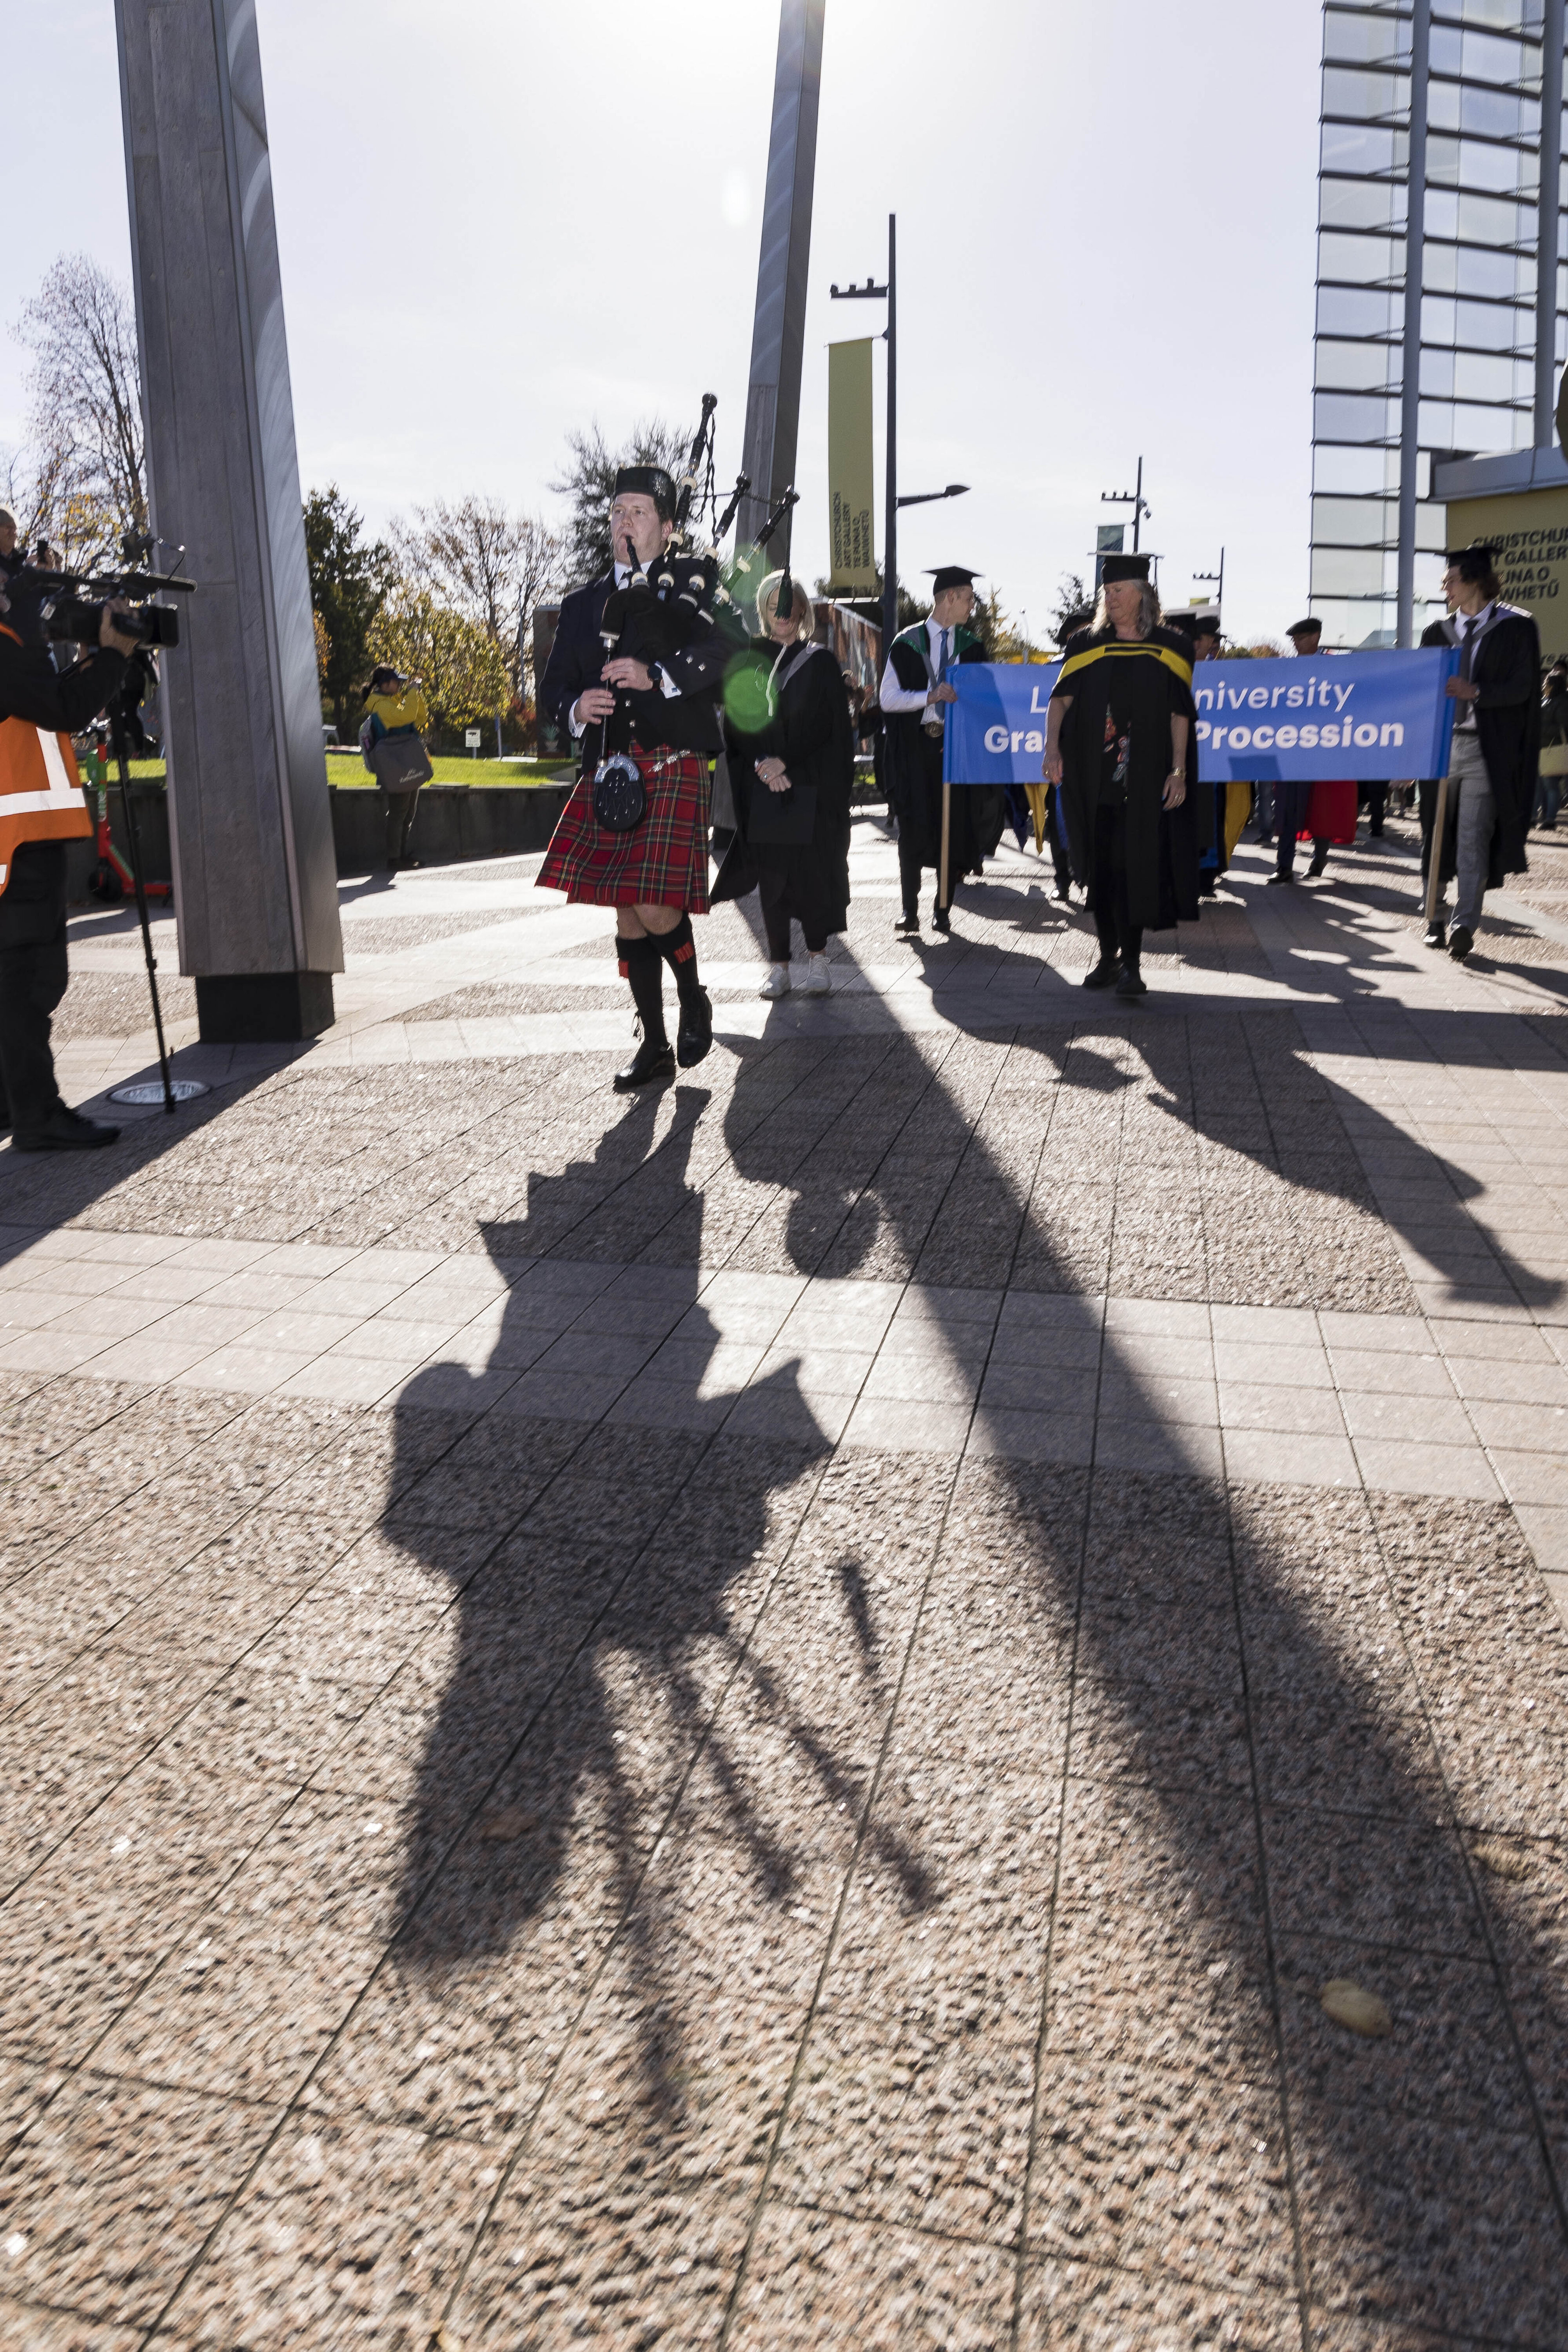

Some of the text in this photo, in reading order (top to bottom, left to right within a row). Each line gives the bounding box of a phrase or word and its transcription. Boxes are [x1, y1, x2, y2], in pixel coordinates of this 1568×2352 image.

[843, 503, 851, 547] GALLERY
[1504, 545, 1568, 566] GALLER
[1537, 566, 1551, 581] O
[1499, 578, 1560, 601] WHETŪ
[1194, 676, 1356, 712] niversity
[1194, 715, 1405, 750] Procession
